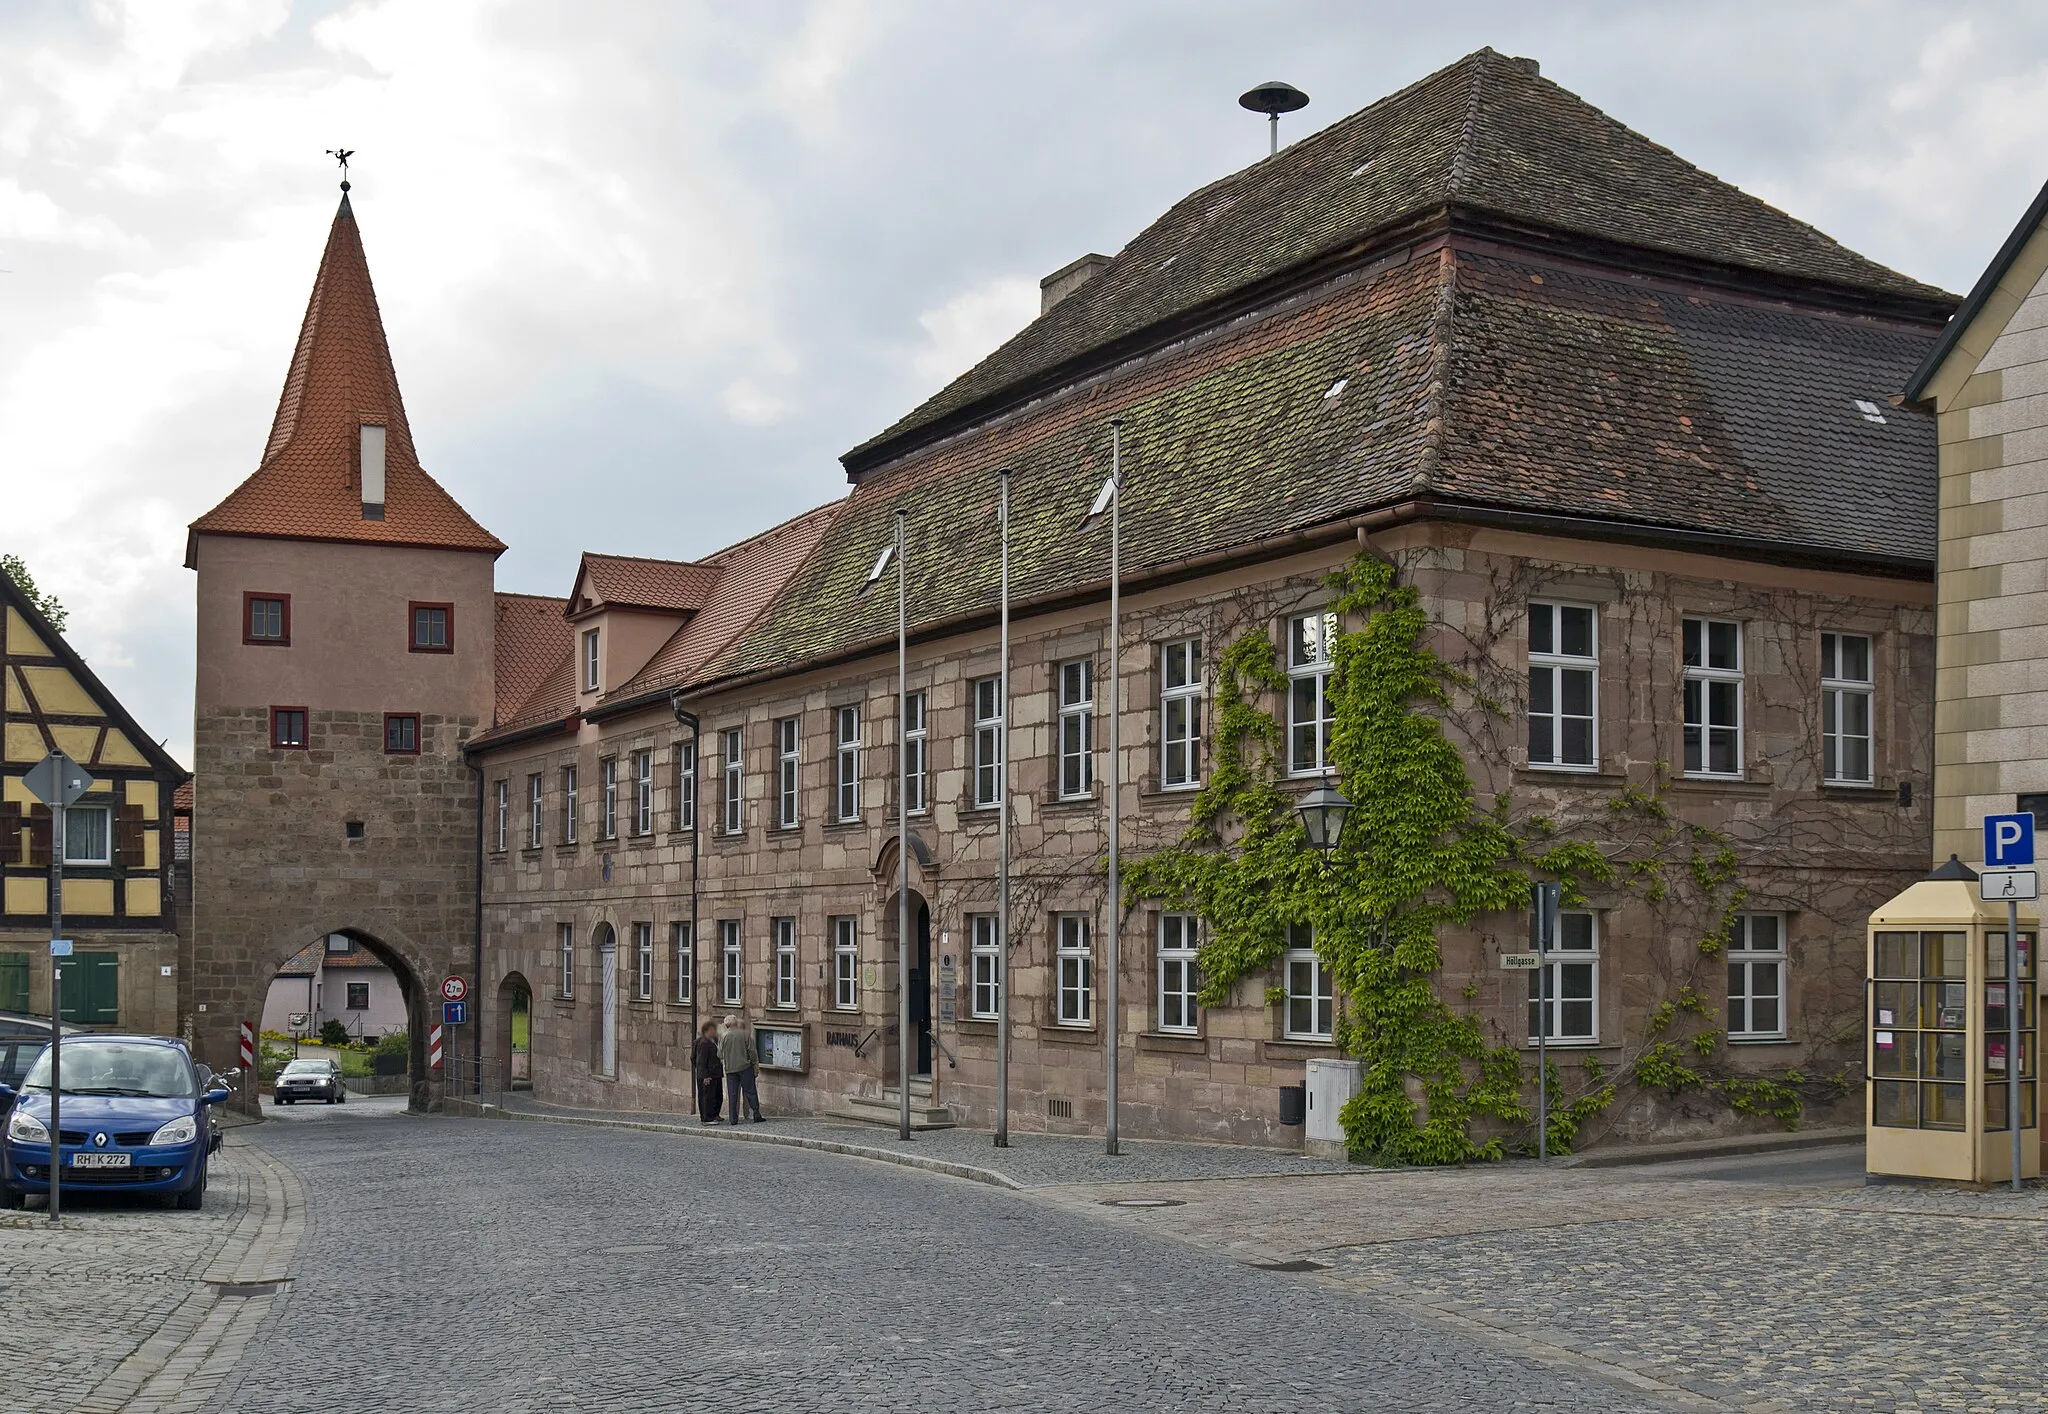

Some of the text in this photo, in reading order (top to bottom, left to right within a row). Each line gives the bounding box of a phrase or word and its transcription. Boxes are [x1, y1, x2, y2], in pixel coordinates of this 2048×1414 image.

[1995, 821, 2022, 860] P
[1506, 956, 1535, 967] Höllgasse
[827, 1031, 858, 1048] RATHAUS
[77, 1155, 127, 1165] RH K 272
